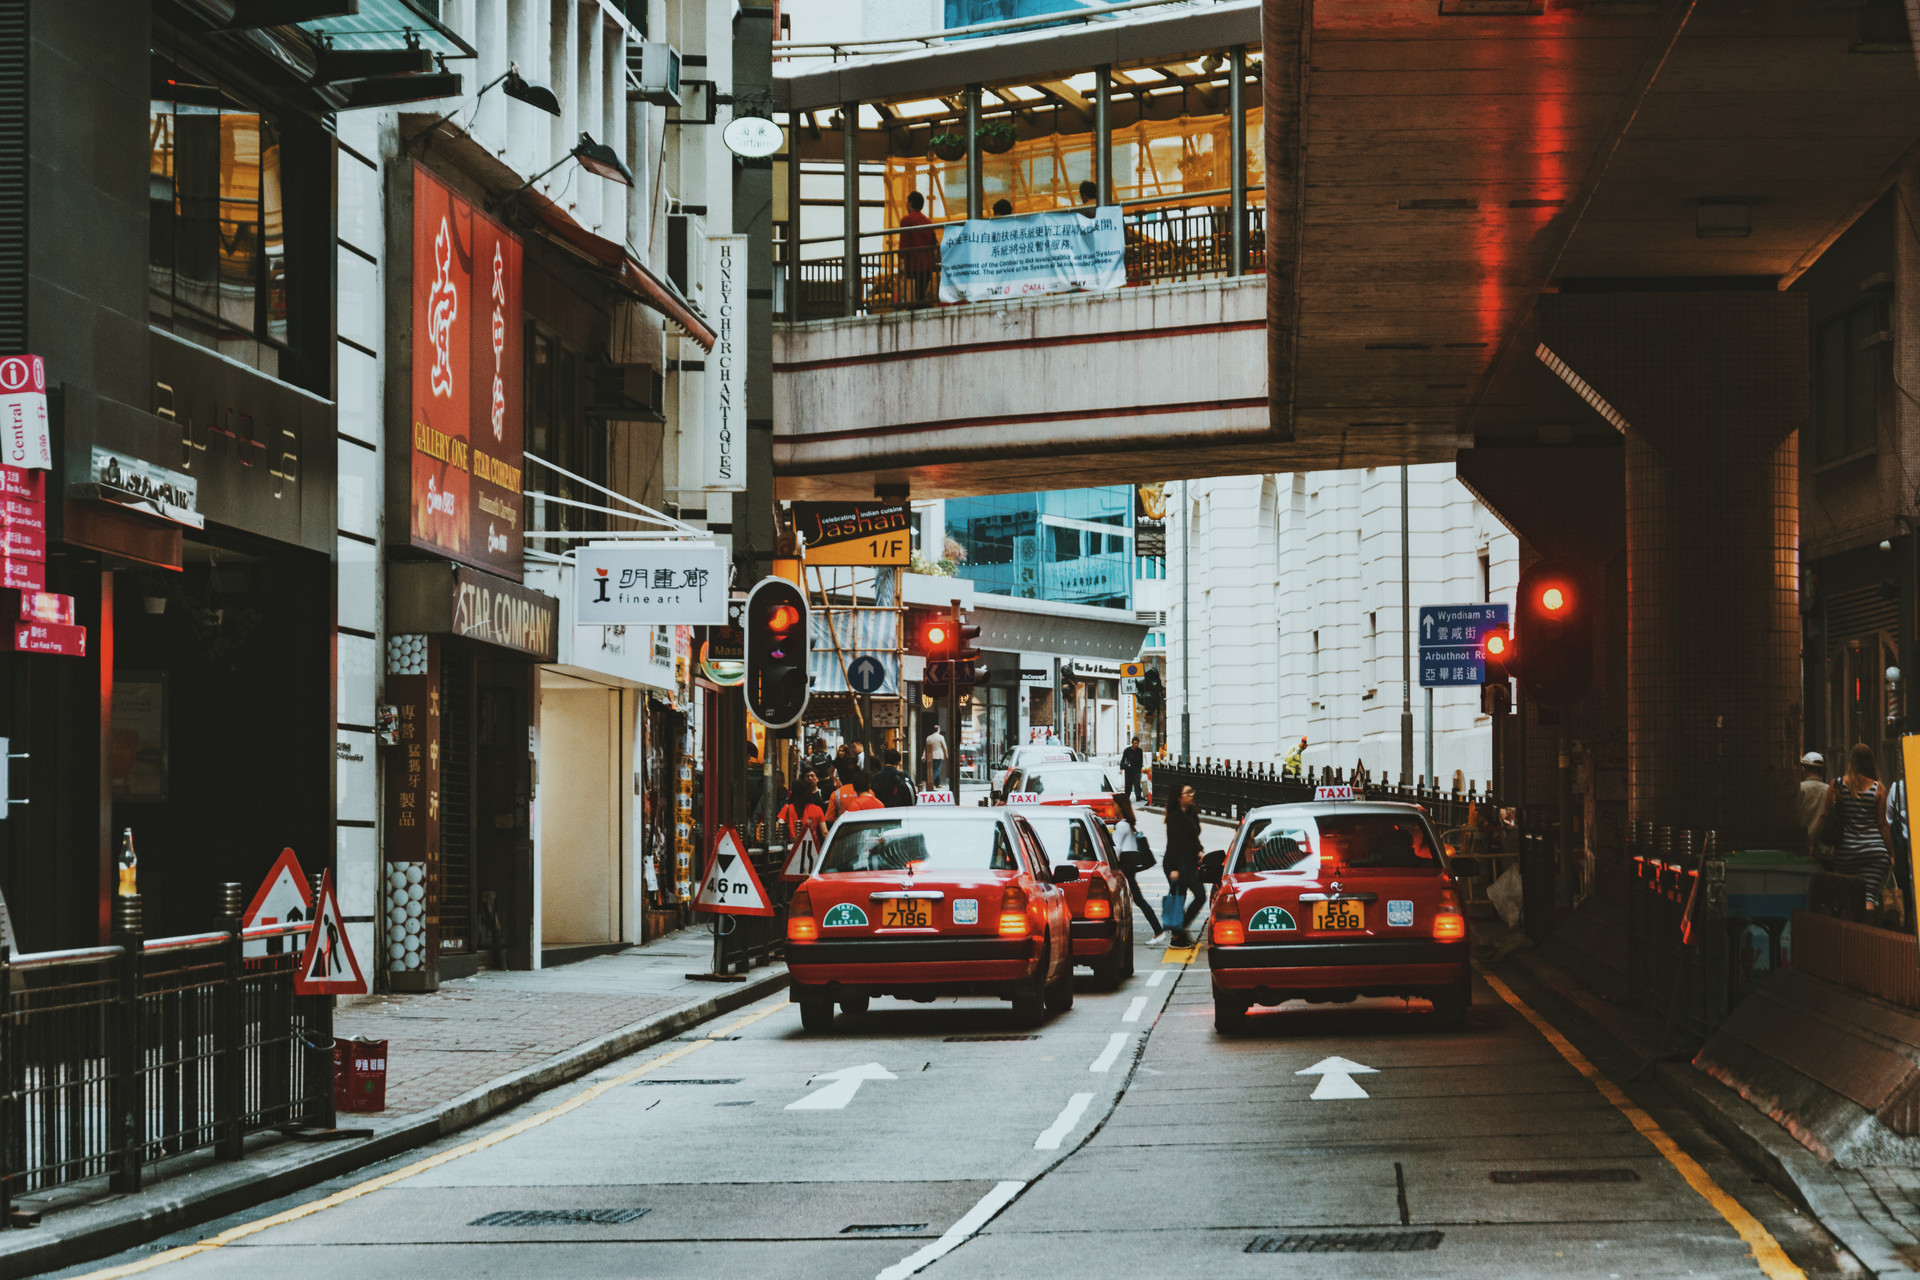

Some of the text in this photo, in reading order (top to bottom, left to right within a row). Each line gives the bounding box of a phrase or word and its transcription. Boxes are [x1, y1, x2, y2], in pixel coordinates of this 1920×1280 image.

[9, 403, 25, 461] Central
[415, 421, 468, 472] GALLERY ONE
[474, 449, 521, 495] STAR COMPANY
[822, 506, 902, 524] celebrating indian cuisine
[804, 507, 906, 546] Jashan
[869, 540, 903, 558] 1/F
[619, 593, 680, 604] fine art
[461, 581, 551, 655] STAR COMPANY
[1437, 609, 1495, 622] Wyndham St
[1437, 626, 1476, 640] 雲咸街
[715, 645, 745, 655] Mass
[1425, 651, 1469, 660] Arbuthnot
[920, 793, 951, 803] TAXI
[1010, 794, 1037, 803] TAXI
[1318, 787, 1350, 798] TAXI
[707, 877, 748, 894] 4.6 m
[897, 899, 918, 913] LU
[1327, 901, 1350, 915] EC
[841, 910, 850, 920] 5
[887, 912, 927, 926] 7186
[1268, 914, 1277, 924] 5
[1318, 915, 1360, 929] 1288
